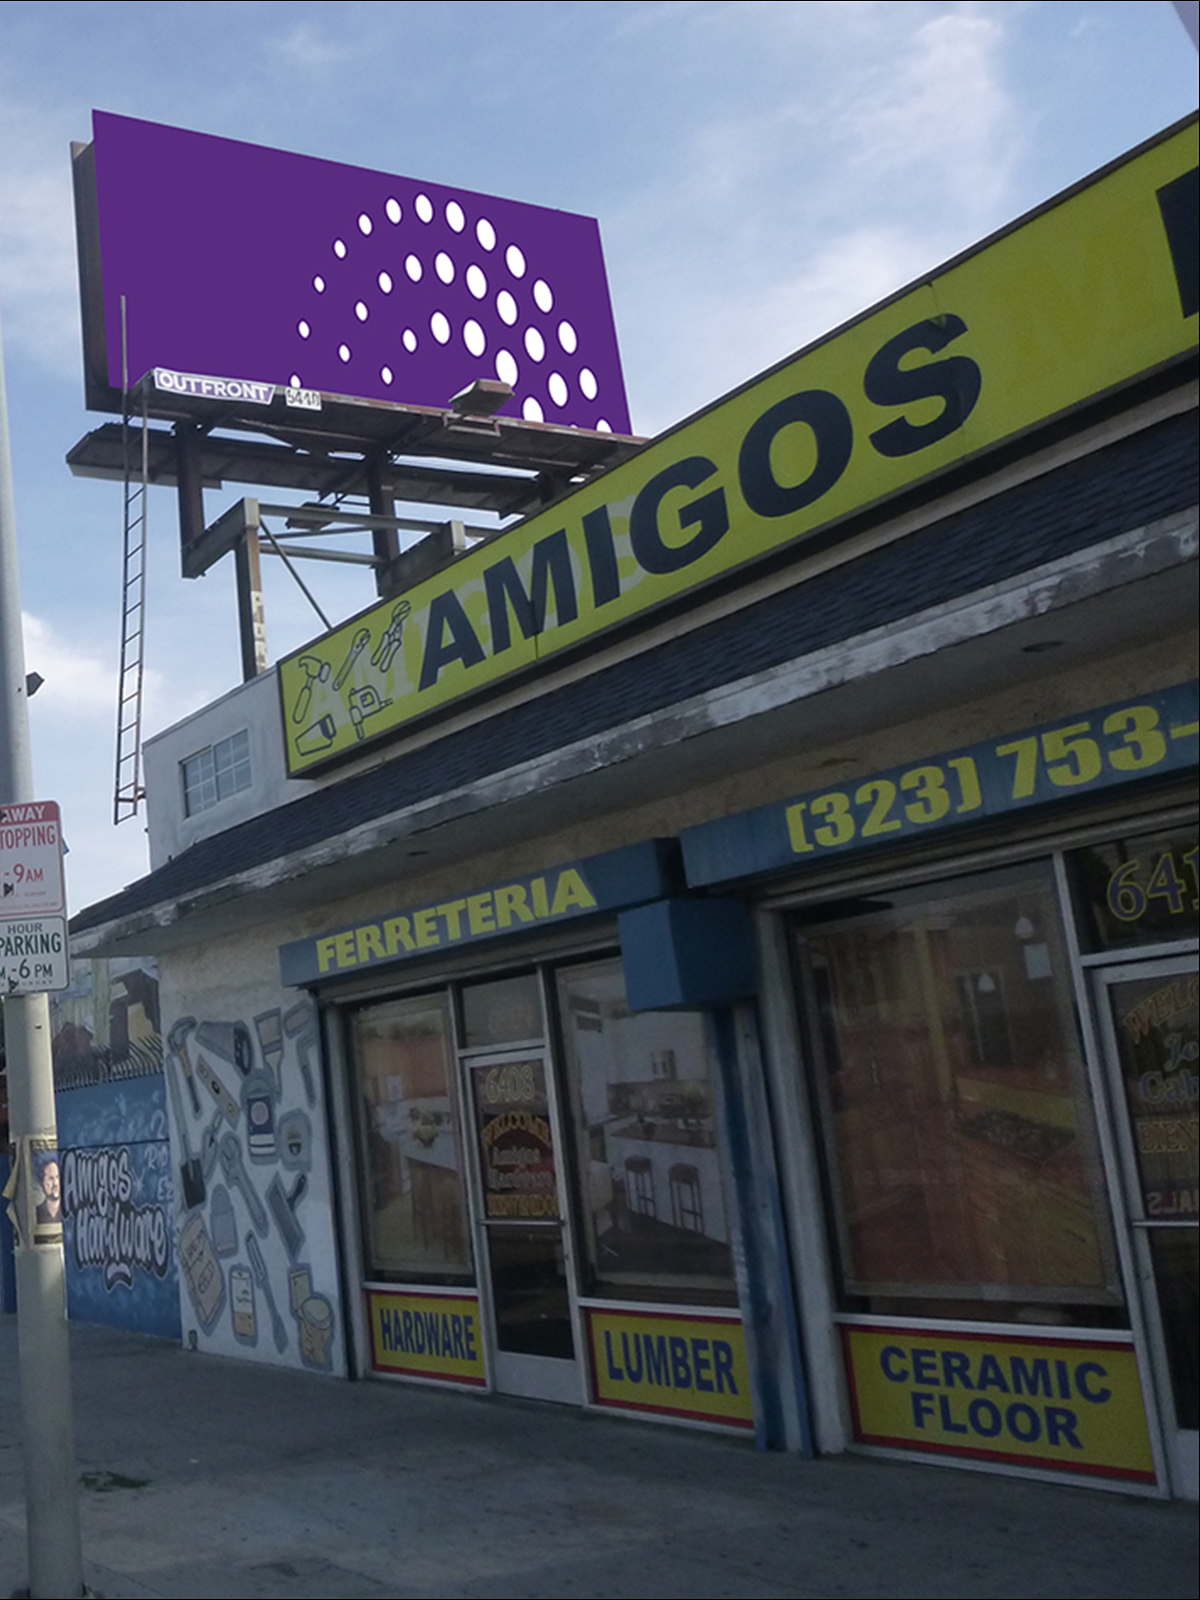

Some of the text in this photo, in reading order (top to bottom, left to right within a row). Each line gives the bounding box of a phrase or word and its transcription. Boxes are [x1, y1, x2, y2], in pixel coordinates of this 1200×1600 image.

[158, 371, 269, 401] OUTFRONT
[417, 312, 983, 693] AMIGOS
[7, 923, 43, 934] HOUR
[316, 868, 597, 973] FERRETERIA
[485, 1065, 535, 1103] 6408
[61, 1147, 132, 1219] Amigos
[74, 1203, 169, 1278] Hardware
[379, 1308, 478, 1361] HARDWARE
[604, 1329, 739, 1396] LUMBER
[880, 1345, 1112, 1404] CERAMIC
[911, 1391, 1084, 1450] FLOOR
